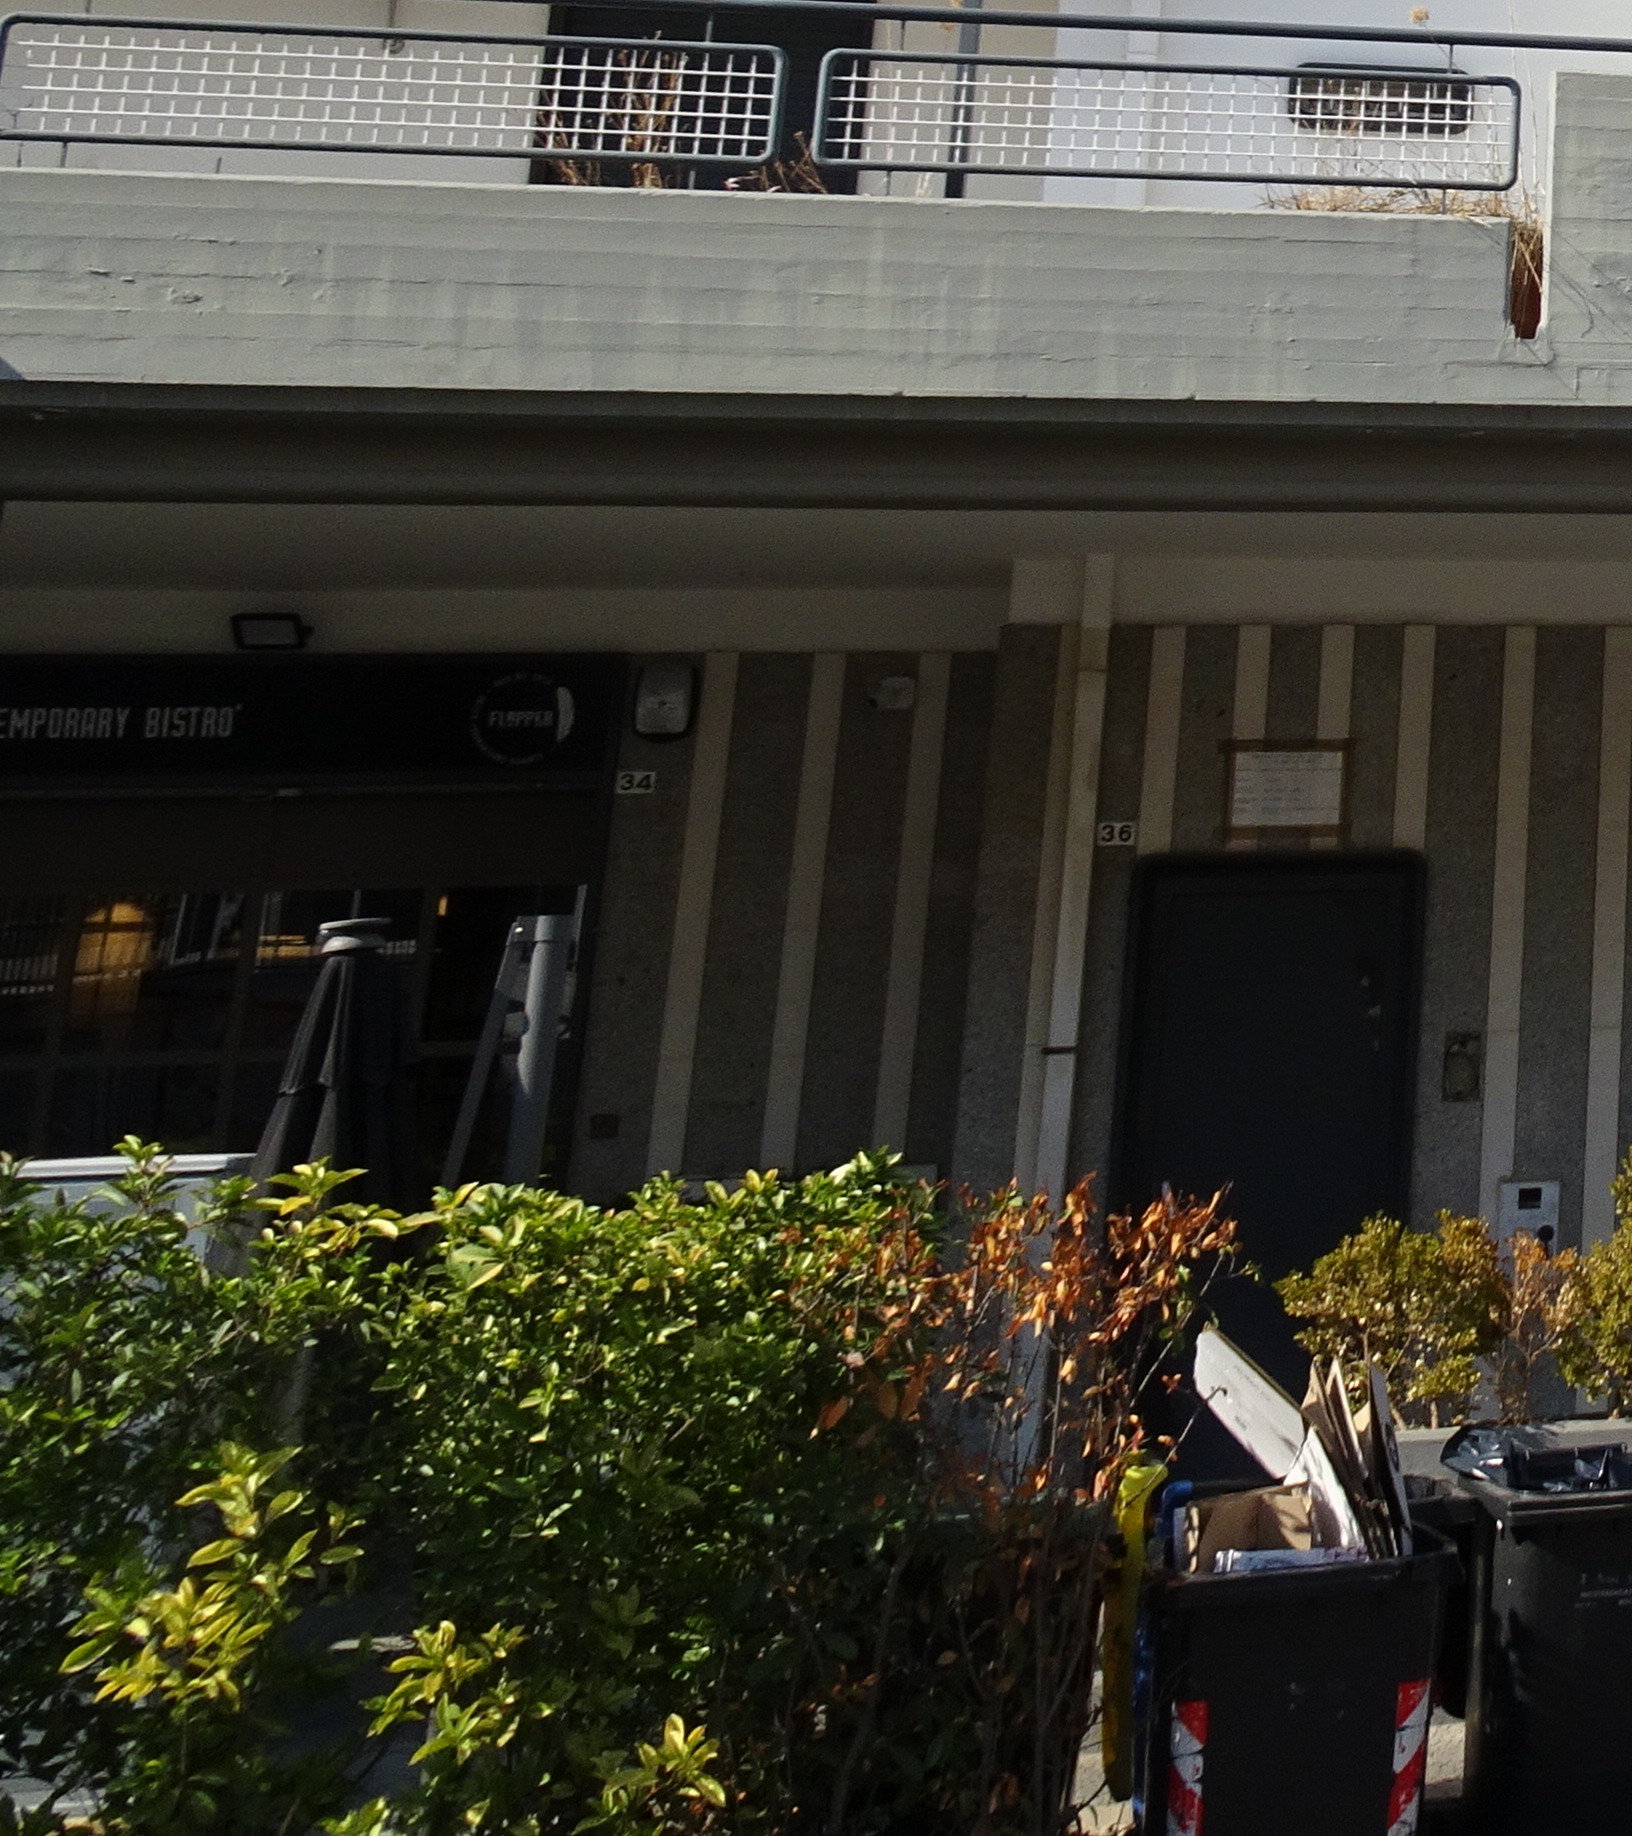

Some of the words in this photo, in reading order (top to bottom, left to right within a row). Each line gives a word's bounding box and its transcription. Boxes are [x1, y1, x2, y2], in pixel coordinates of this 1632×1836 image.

[144, 705, 234, 738] BISTRO
[620, 773, 652, 791] 34
[1100, 824, 1132, 843] 36
